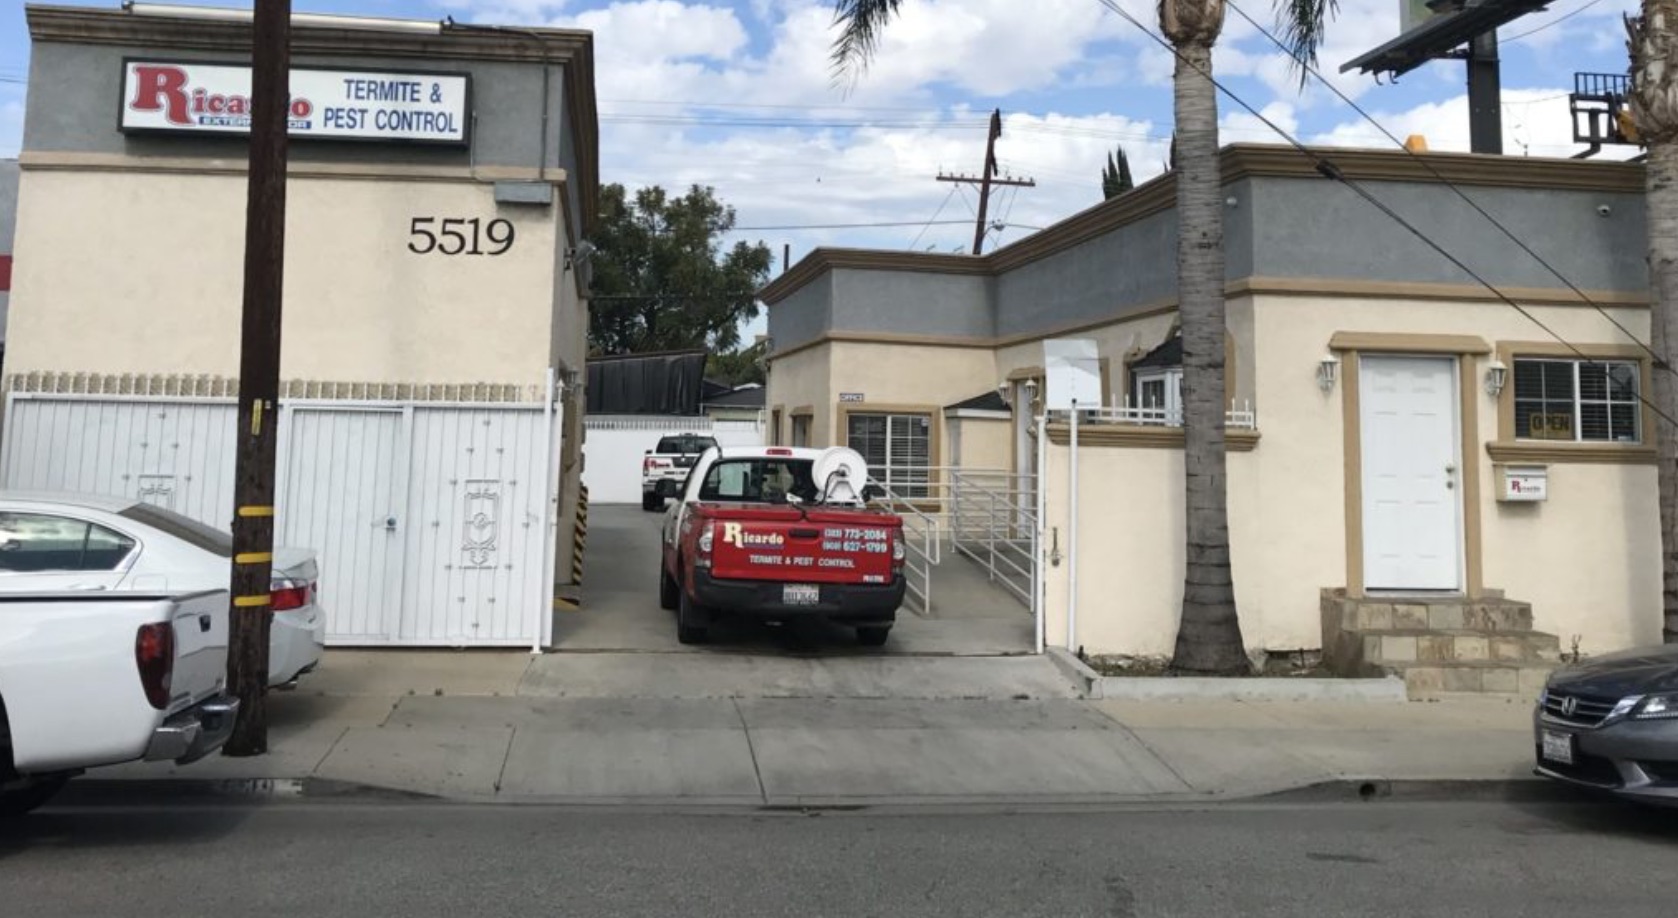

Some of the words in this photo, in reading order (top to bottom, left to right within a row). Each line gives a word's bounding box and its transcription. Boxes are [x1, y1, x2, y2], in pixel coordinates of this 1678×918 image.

[130, 65, 311, 126] Ricao
[344, 79, 421, 102] TERMITE
[430, 83, 442, 103] &
[324, 107, 368, 129] PEST
[375, 110, 458, 133] CONTROL
[408, 217, 515, 256] 5519
[1533, 415, 1569, 431] OPEN
[723, 522, 784, 548] Ricardo
[749, 555, 782, 565] TERMITE
[785, 557, 791, 565] &
[793, 557, 814, 567] PEST
[818, 558, 855, 568] CONTROL
